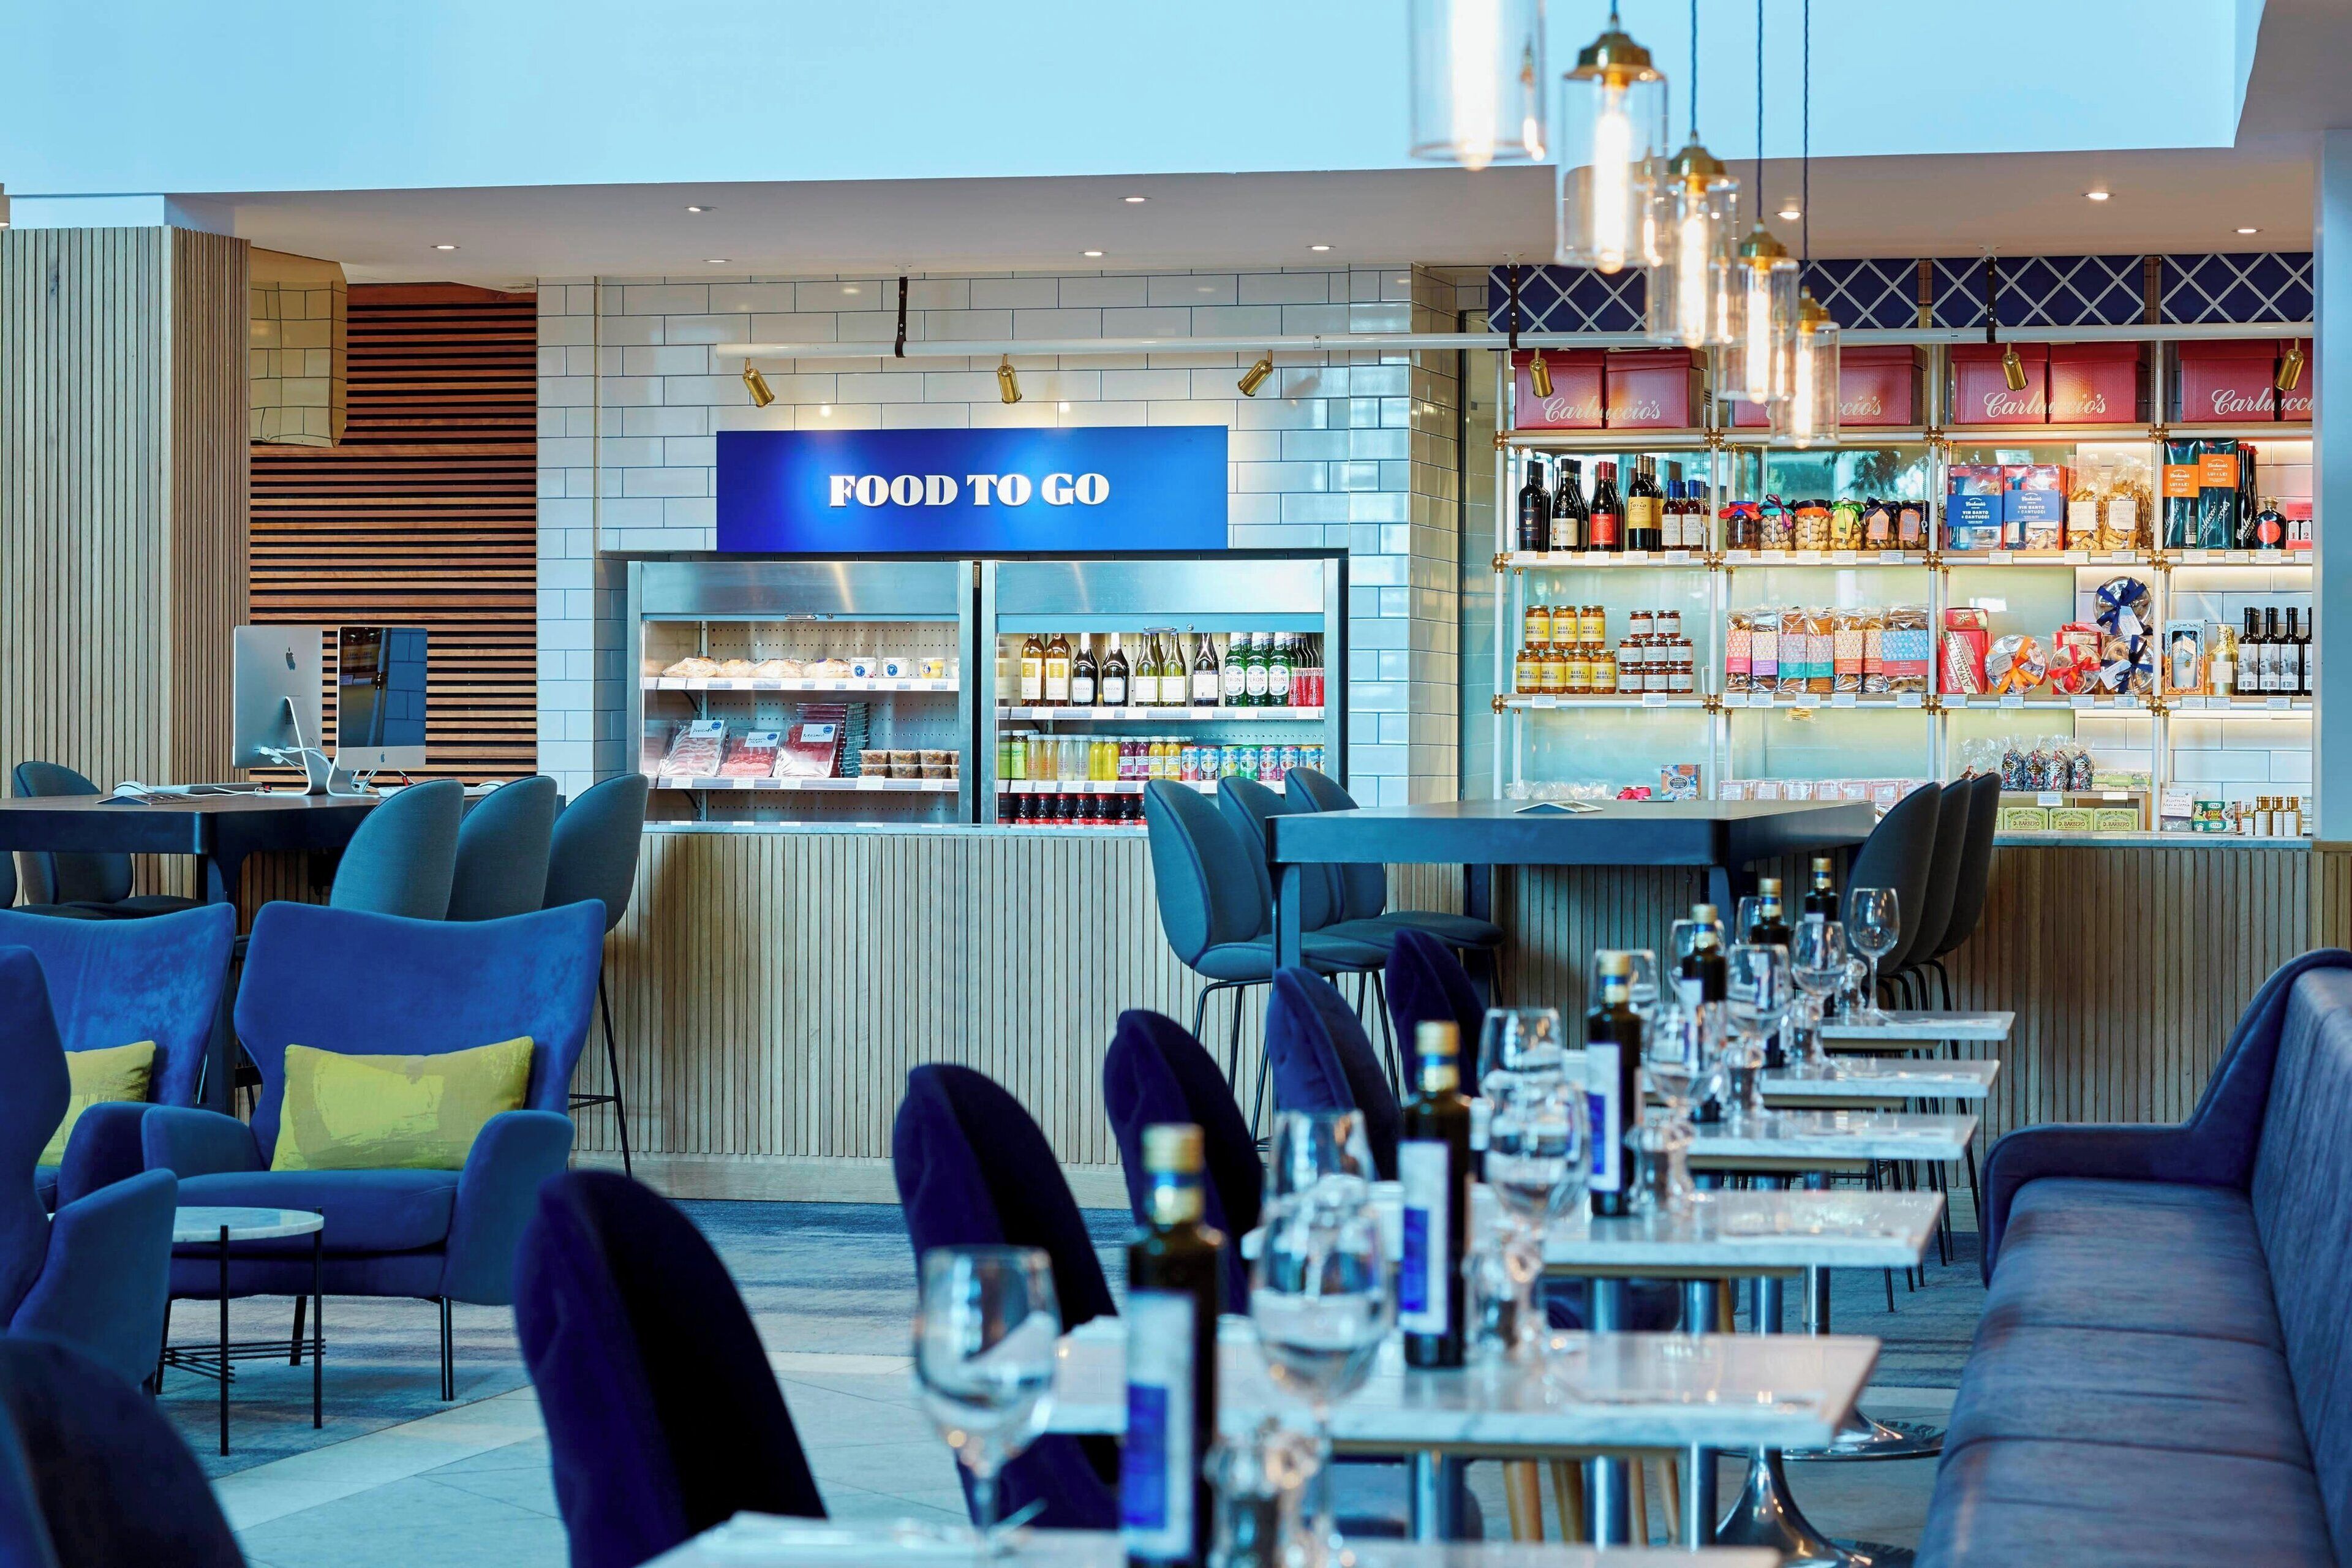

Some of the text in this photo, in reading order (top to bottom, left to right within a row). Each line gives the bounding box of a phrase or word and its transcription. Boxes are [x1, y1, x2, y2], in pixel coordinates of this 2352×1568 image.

[1543, 396, 1660, 422] Carluccio's
[1984, 391, 2106, 418] Carlucio's
[2211, 388, 2313, 415] Carlucci
[829, 473, 1109, 507] FOOD TO GO
